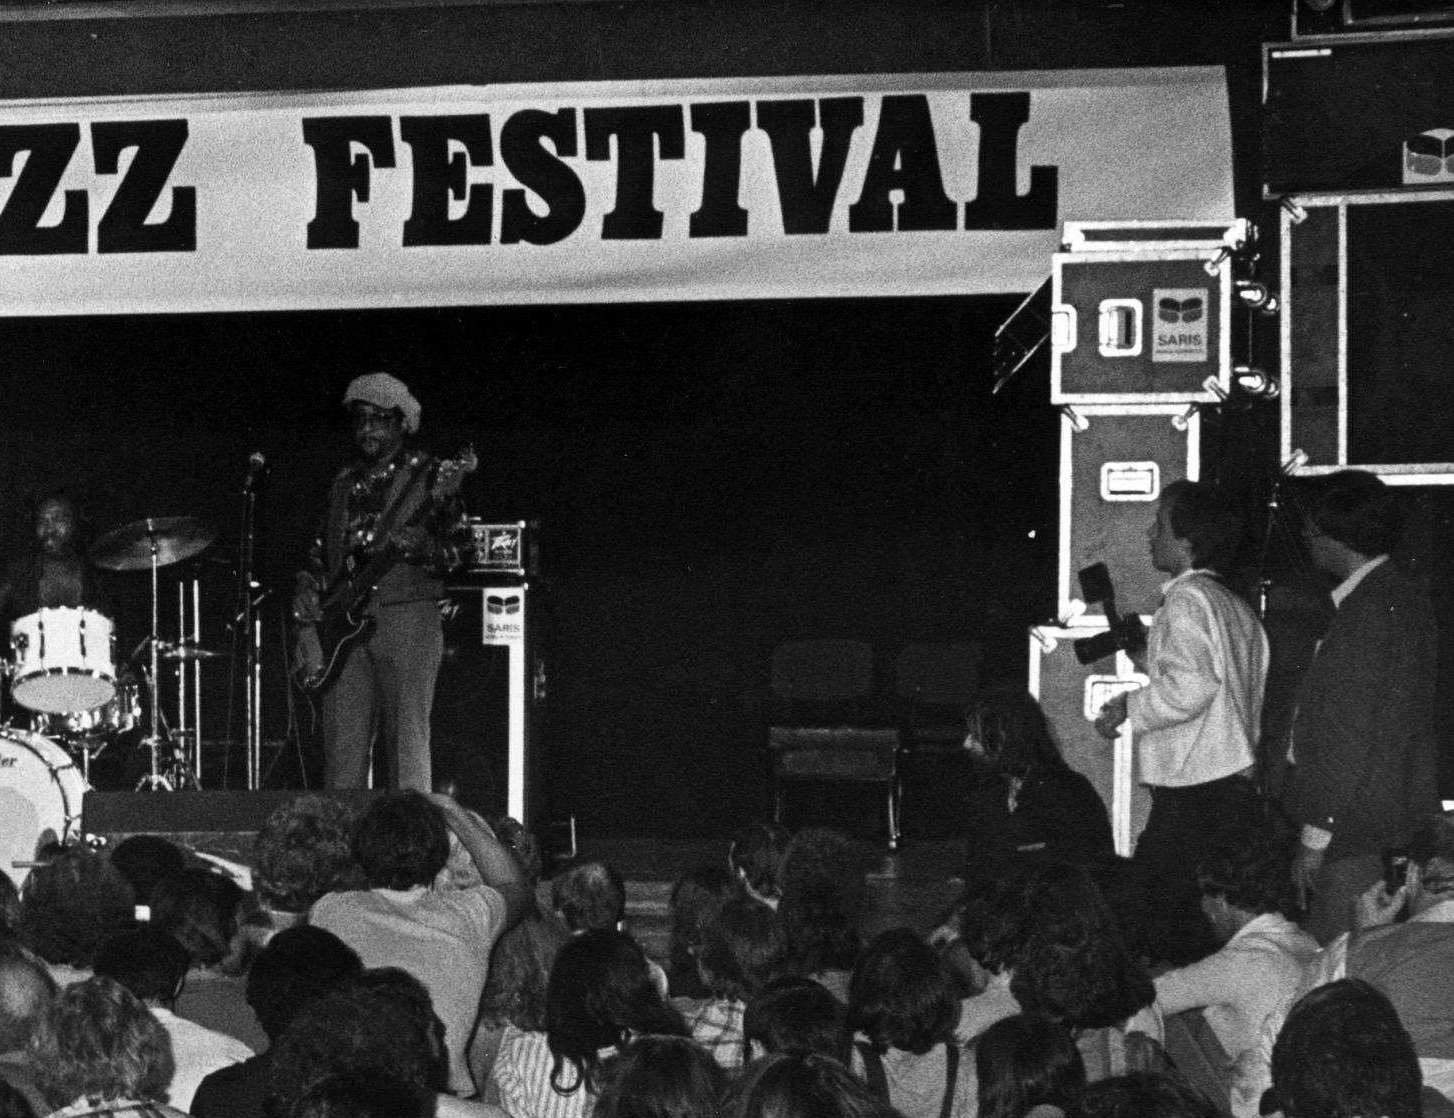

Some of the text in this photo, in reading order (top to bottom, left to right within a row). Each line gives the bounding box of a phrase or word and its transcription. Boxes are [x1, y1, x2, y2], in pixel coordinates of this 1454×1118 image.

[302, 92, 1058, 249] FESTIVAL
[1157, 334, 1203, 346] SARIS
[487, 623, 520, 633] SARIS
